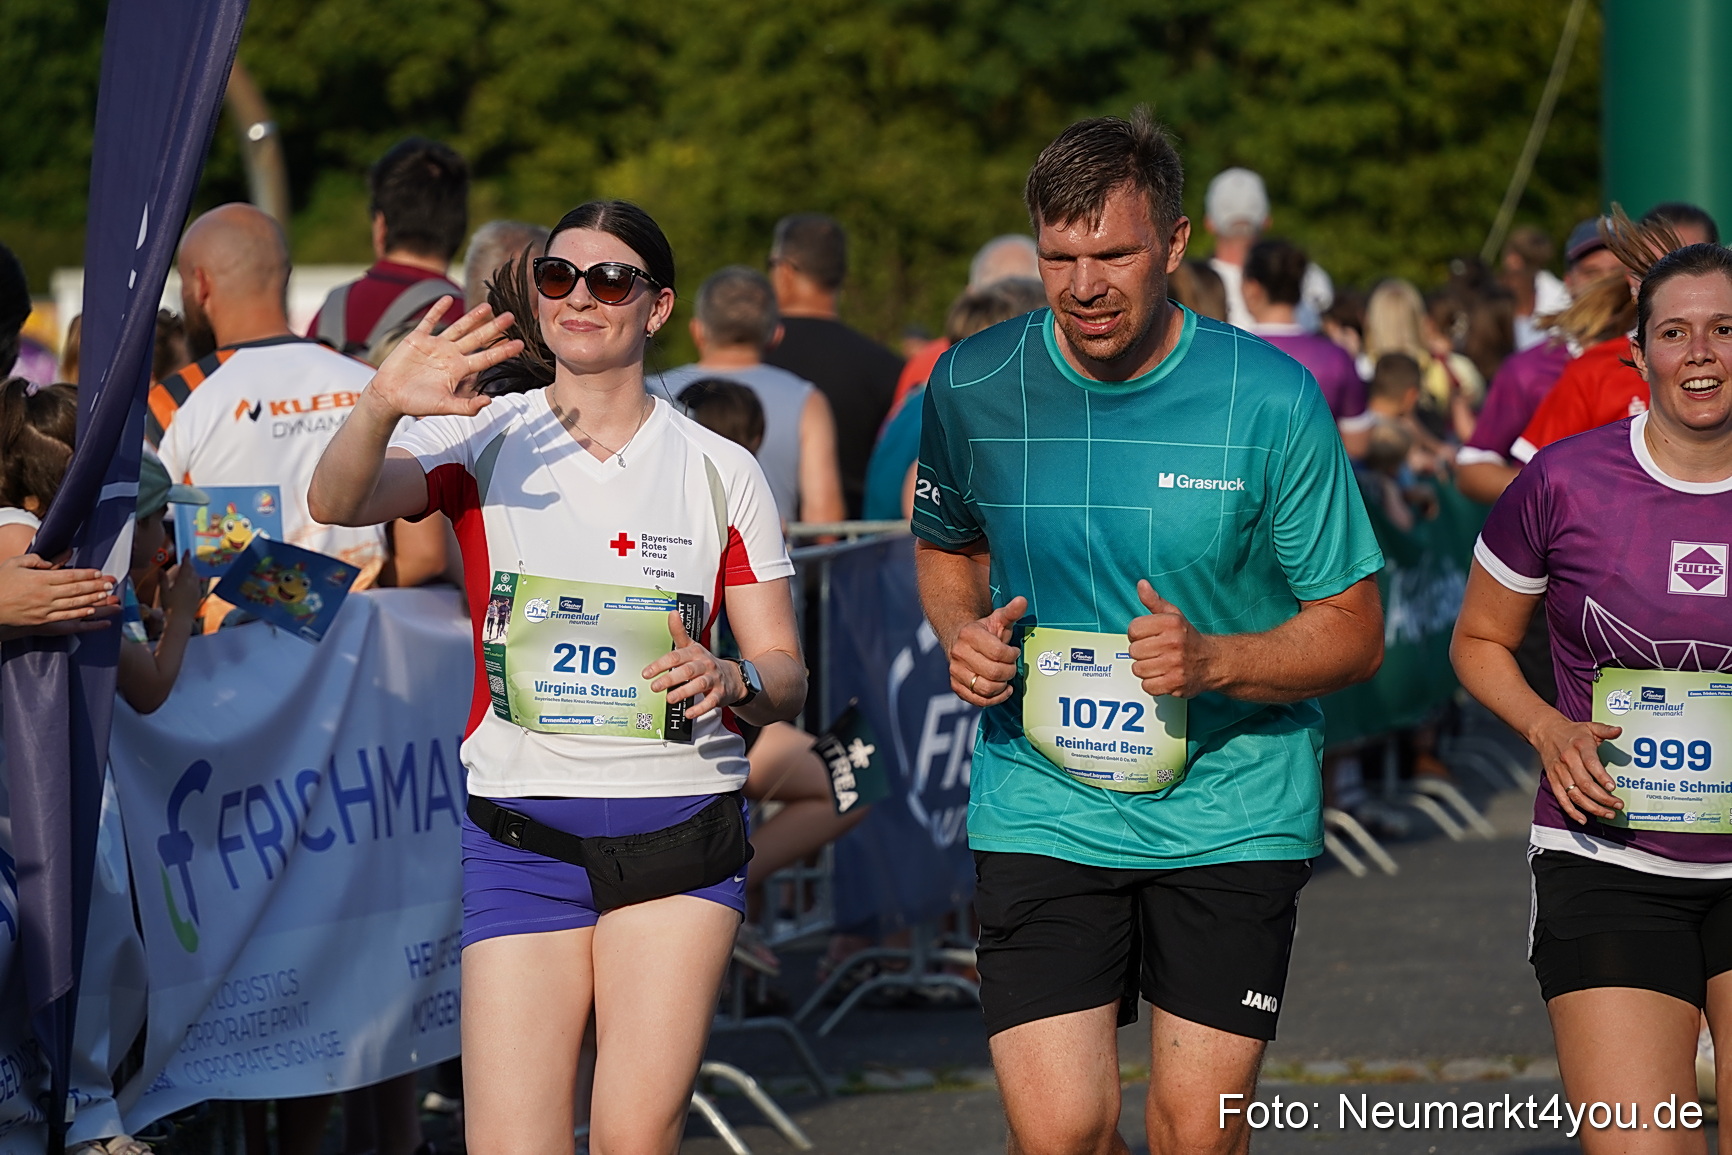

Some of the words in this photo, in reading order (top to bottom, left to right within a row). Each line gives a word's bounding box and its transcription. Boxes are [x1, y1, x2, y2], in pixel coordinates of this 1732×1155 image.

[269, 390, 361, 416] KLEB
[1176, 474, 1246, 491] Grasruck
[641, 533, 692, 546] Bayerisches
[641, 542, 668, 551] Rotes
[641, 550, 668, 560] Kreuz
[642, 566, 675, 578] Virginia
[1674, 562, 1724, 574] FUCHS
[494, 583, 512, 592] AOK
[550, 610, 600, 620] Firmenlauf
[553, 642, 616, 676] 216
[1064, 662, 1112, 672] Firmenlauf
[534, 680, 587, 696] Virginia
[590, 684, 637, 698] Strauß
[1058, 696, 1145, 733] 1072
[1634, 702, 1684, 711] Firmenlauf
[1055, 736, 1116, 753] Reinhard
[1120, 742, 1154, 756] Benz
[1634, 737, 1712, 772] 999
[1616, 776, 1676, 792] Stefanie
[217, 968, 300, 1010] LOGISTICS
[1242, 990, 1278, 1013] JAKO
[272, 1001, 310, 1033] PRINT
[184, 1046, 280, 1084] CORPORATE
